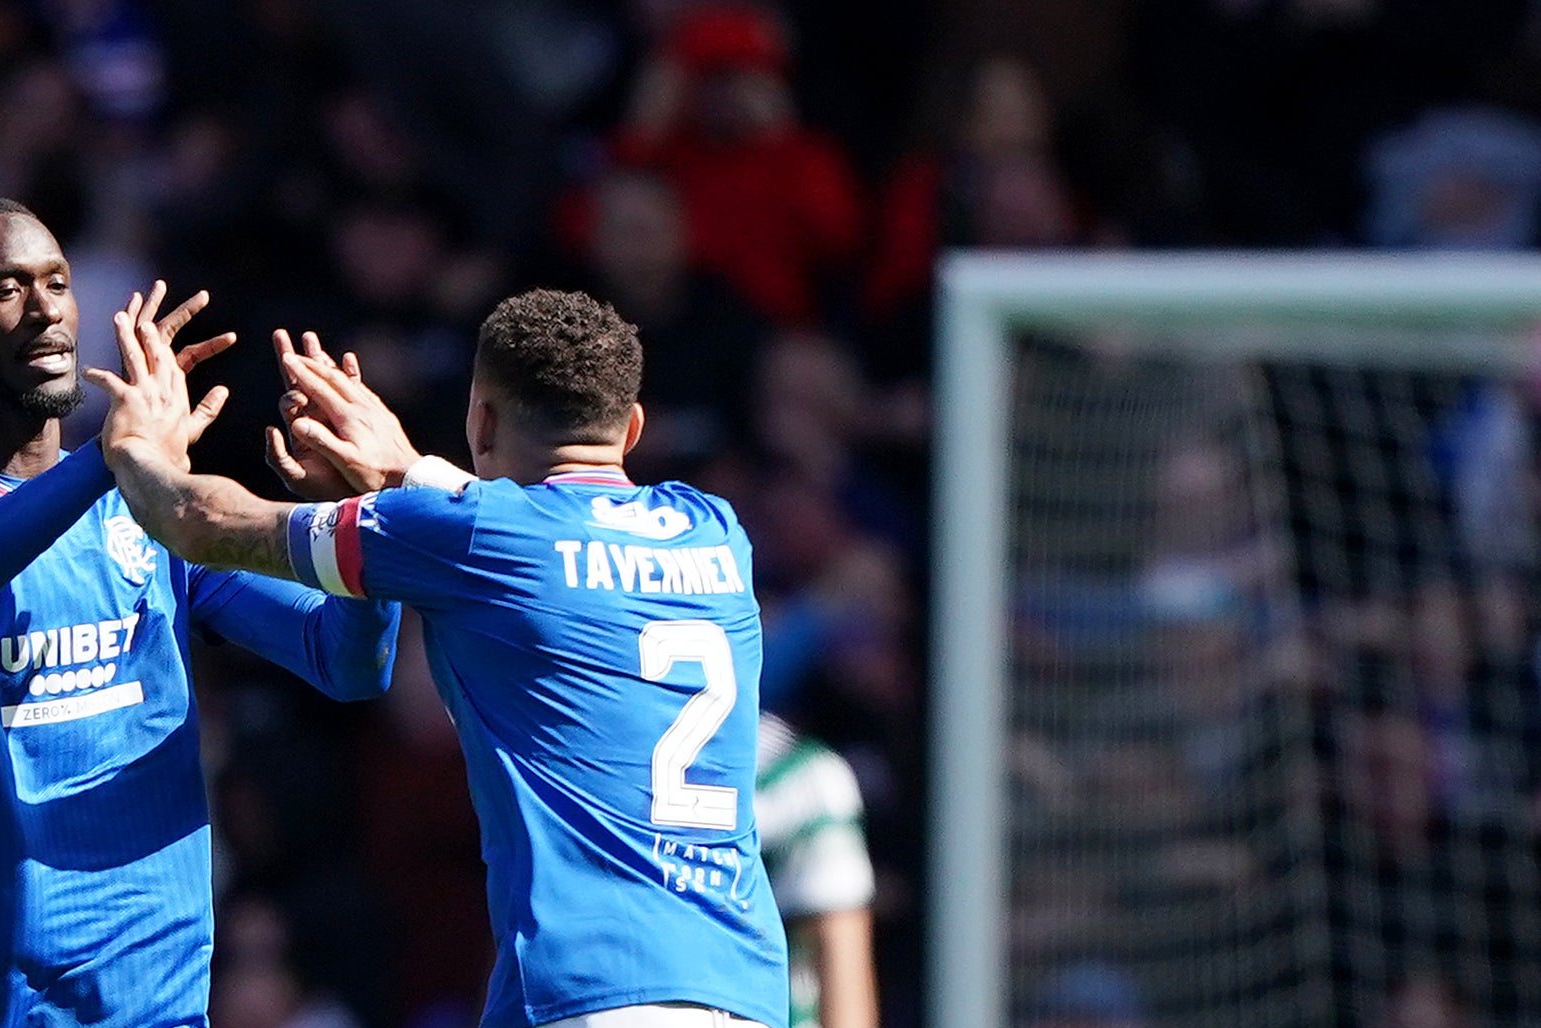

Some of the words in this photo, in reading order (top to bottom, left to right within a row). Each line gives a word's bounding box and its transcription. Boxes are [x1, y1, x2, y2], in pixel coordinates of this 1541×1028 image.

[554, 540, 745, 595] TAVERNIER
[0, 612, 140, 673] UNIBET
[639, 619, 738, 831] 2
